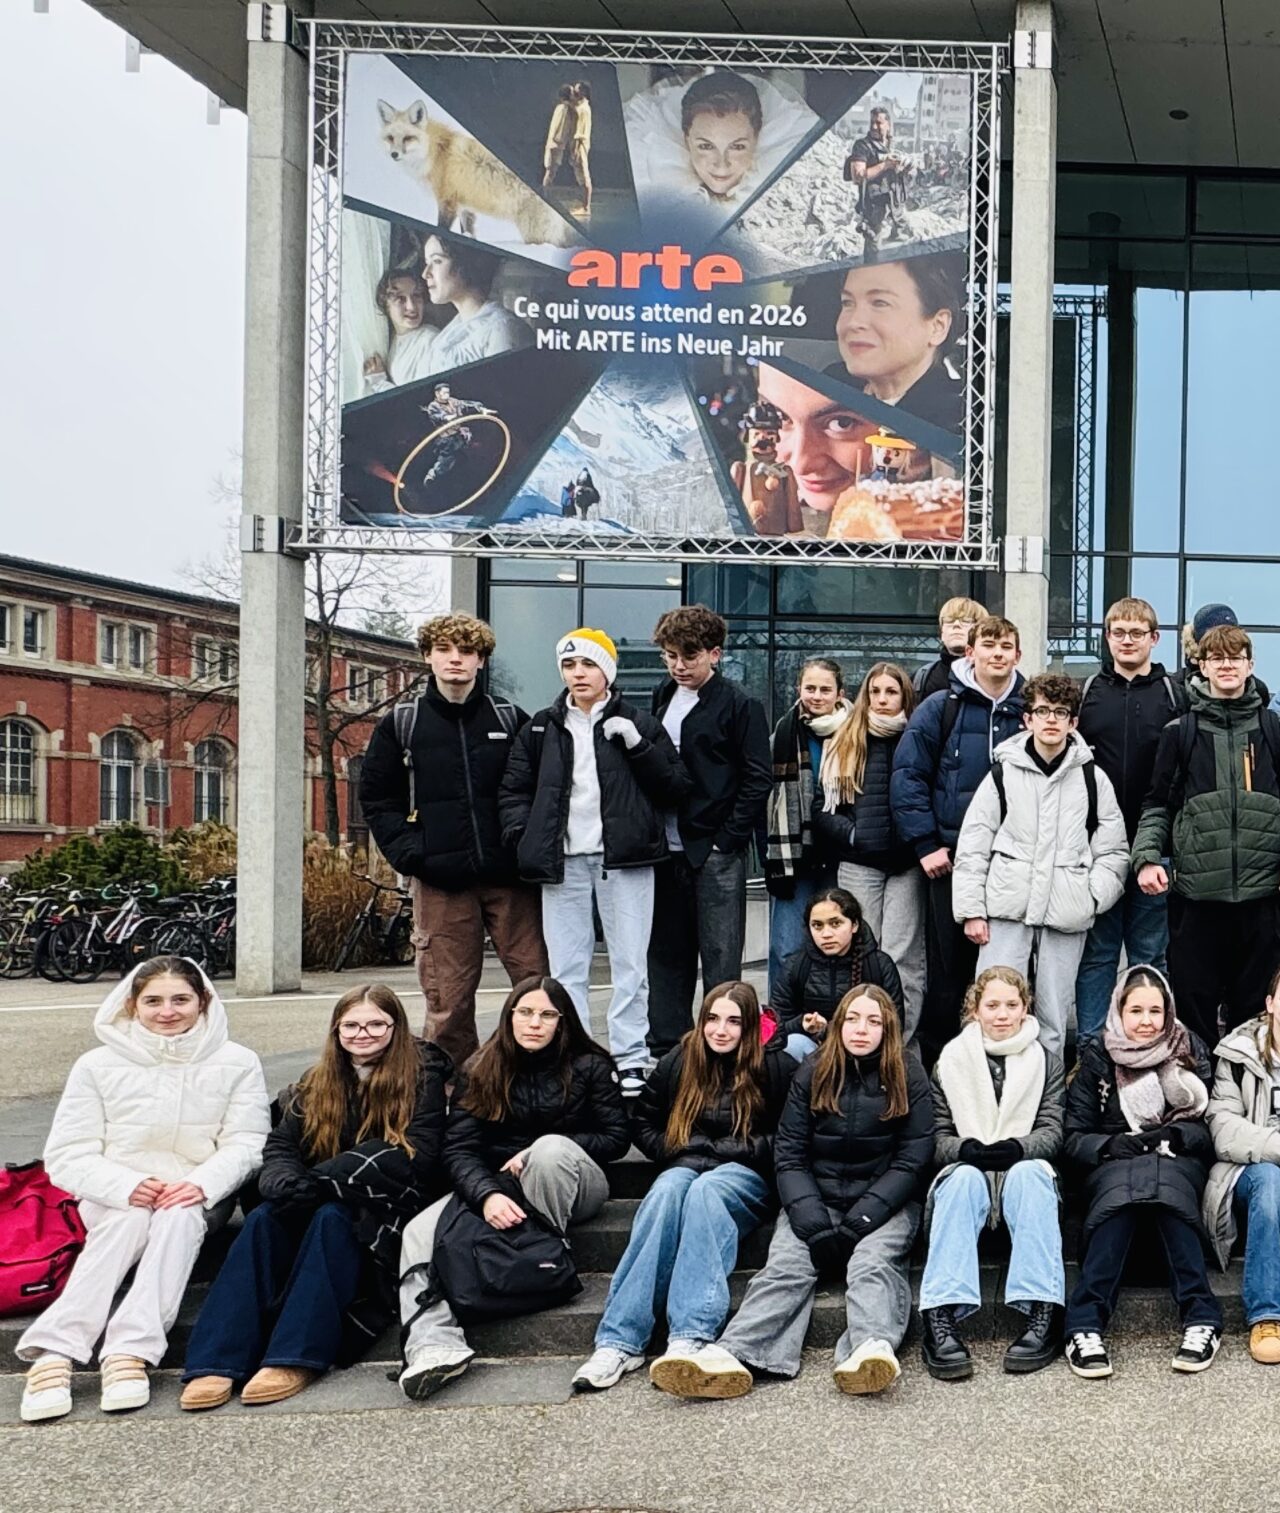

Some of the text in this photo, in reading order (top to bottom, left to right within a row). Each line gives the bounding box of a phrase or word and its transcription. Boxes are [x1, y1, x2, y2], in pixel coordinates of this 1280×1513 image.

[568, 245, 743, 290] arte
[513, 296, 808, 326] Ce qui vous attend en 2026
[536, 328, 786, 358] Mit ARTE ins Neue Jahr
